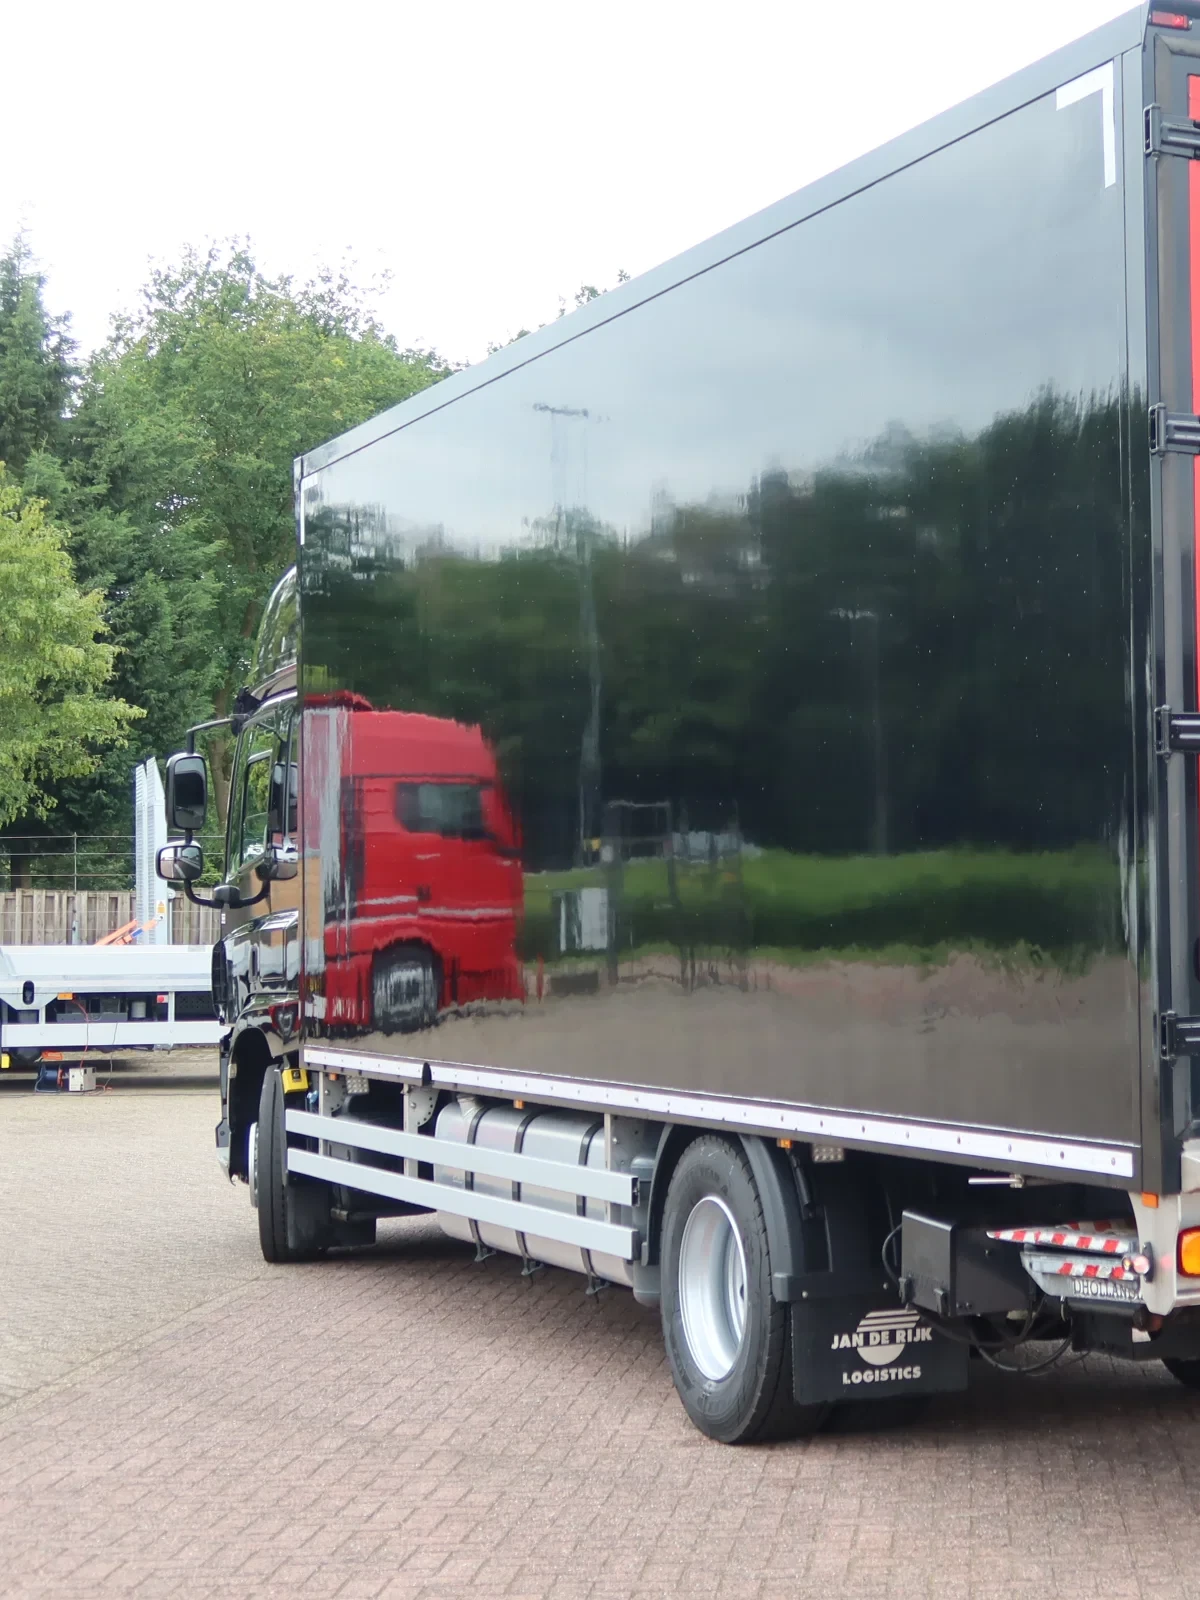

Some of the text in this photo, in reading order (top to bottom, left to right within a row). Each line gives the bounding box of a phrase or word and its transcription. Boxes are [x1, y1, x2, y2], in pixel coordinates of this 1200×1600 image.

[831, 1327, 932, 1350] JAN DE RIJK
[842, 1366, 922, 1385] LOGISTICS
